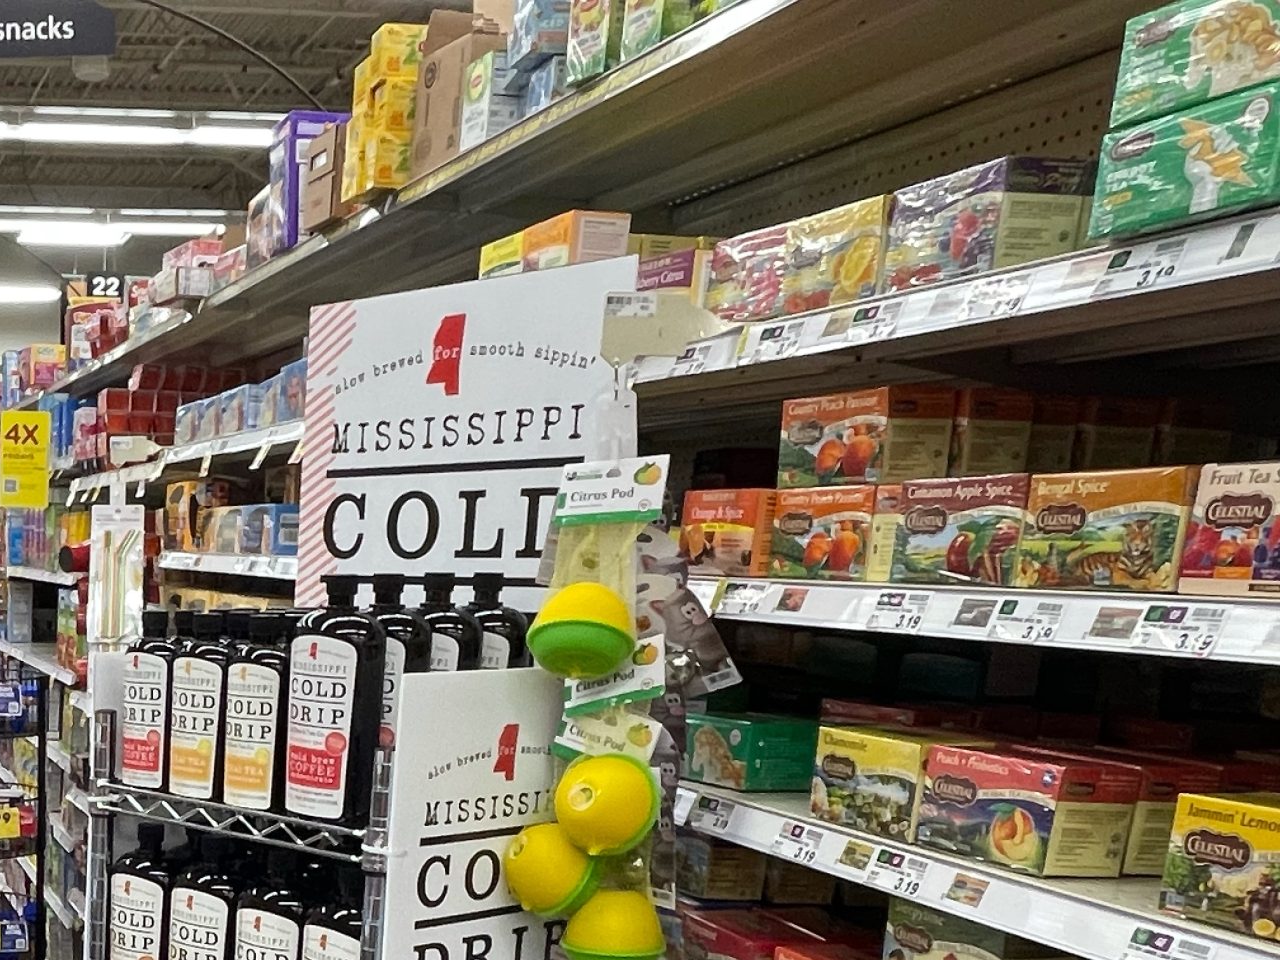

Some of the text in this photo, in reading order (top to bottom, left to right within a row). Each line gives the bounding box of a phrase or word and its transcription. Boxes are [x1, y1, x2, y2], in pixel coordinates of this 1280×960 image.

[91, 275, 120, 297] 22
[335, 342, 597, 396] slow brewed for smooth sippin'
[4, 423, 40, 446] 4X
[330, 403, 587, 455] MISSISSIPPI
[1210, 468, 1271, 486] Fruit Tea
[569, 486, 636, 503] Citrus Pod
[985, 481, 1013, 498] Spice
[1036, 479, 1110, 498] Bengal Spice
[1037, 508, 1084, 528] CELESTIAL
[1207, 503, 1267, 524] CELESTIAL
[612, 668, 636, 686] Pod
[291, 677, 348, 700] COLD
[290, 702, 346, 726] DRIP
[602, 736, 627, 752] Pod
[427, 761, 452, 781] slow
[456, 749, 493, 768] brewed
[423, 789, 555, 828] MISSISSI
[1187, 801, 1239, 824] Jammin'
[1186, 835, 1245, 863] CELESTIAL
[893, 876, 920, 896] 3.19
[171, 923, 220, 947] COLD
